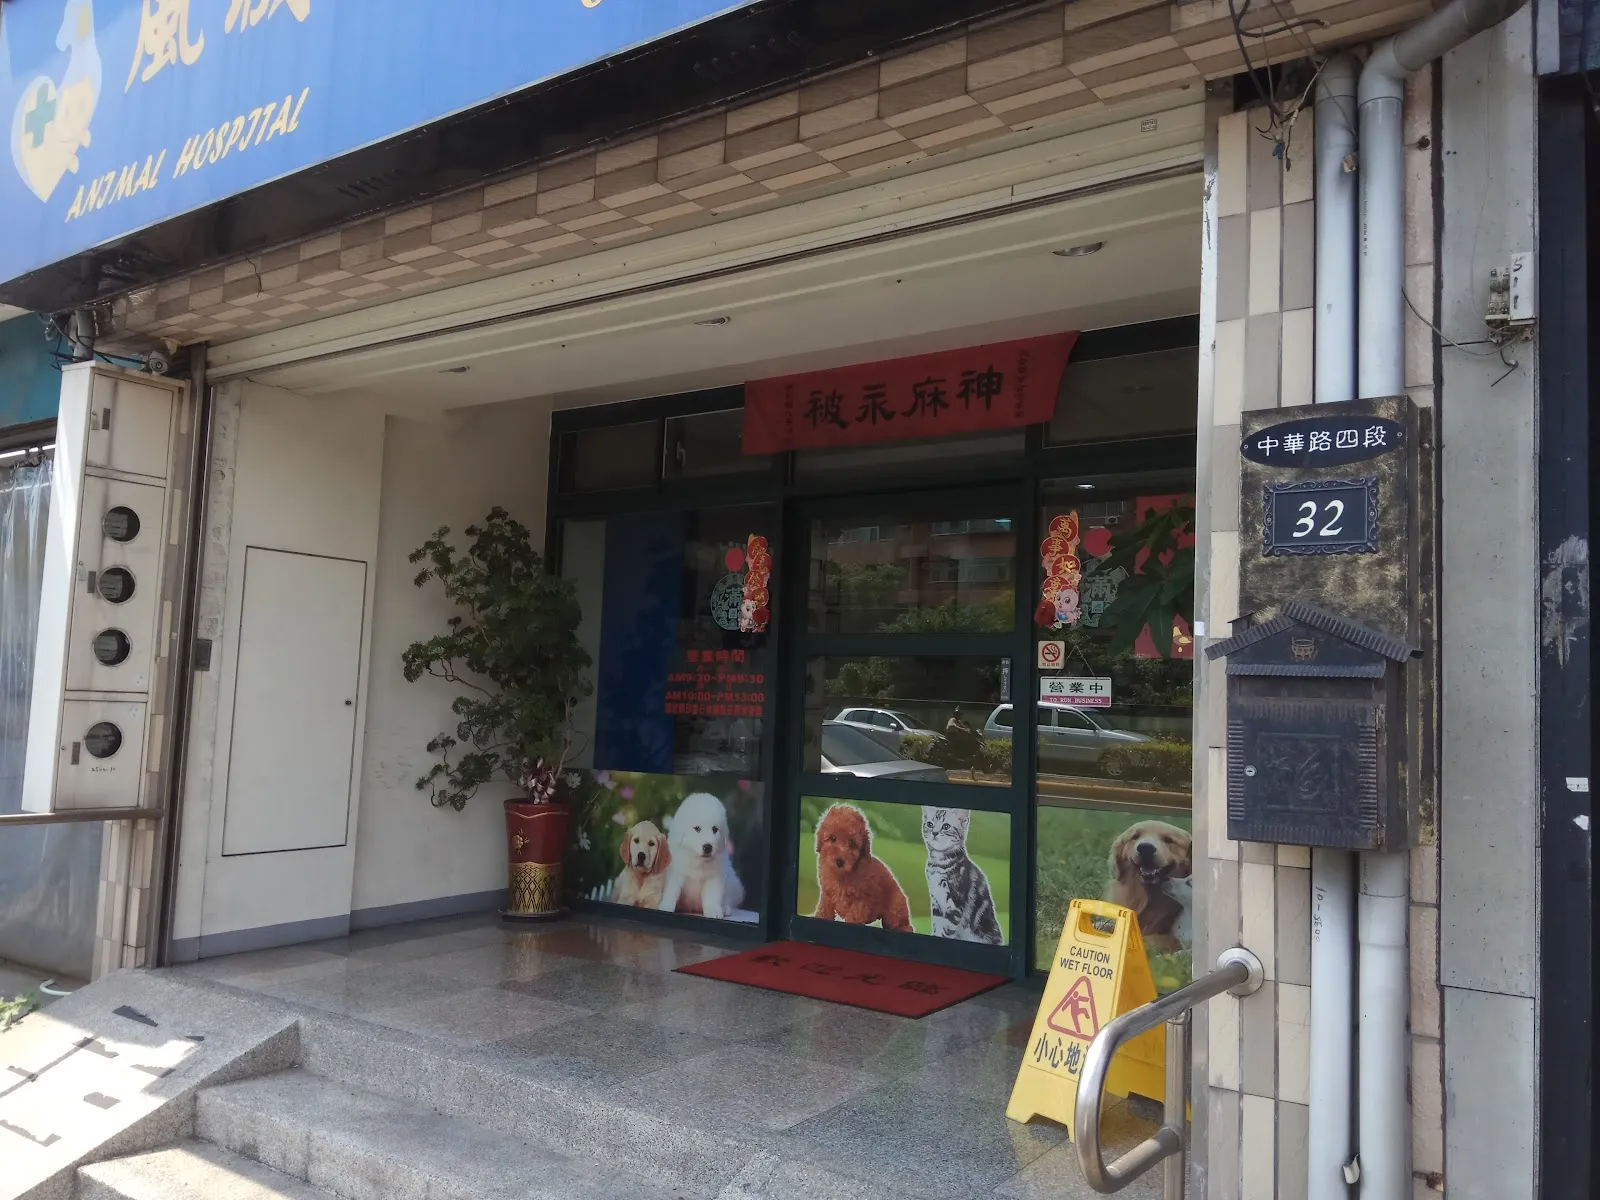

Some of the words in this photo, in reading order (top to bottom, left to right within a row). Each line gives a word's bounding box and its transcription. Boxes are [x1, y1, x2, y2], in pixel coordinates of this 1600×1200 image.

[65, 149, 167, 223] ANIMAL
[173, 87, 309, 178] HOSPITAL
[1257, 425, 1387, 456] 中華路四段
[1292, 499, 1345, 538] 32
[1049, 681, 1103, 694] 營業中
[1060, 957, 1079, 971] WET
[1082, 960, 1114, 980] FLOOR
[1069, 945, 1111, 964] CAUTION
[1034, 1032, 1091, 1075] 小心地
